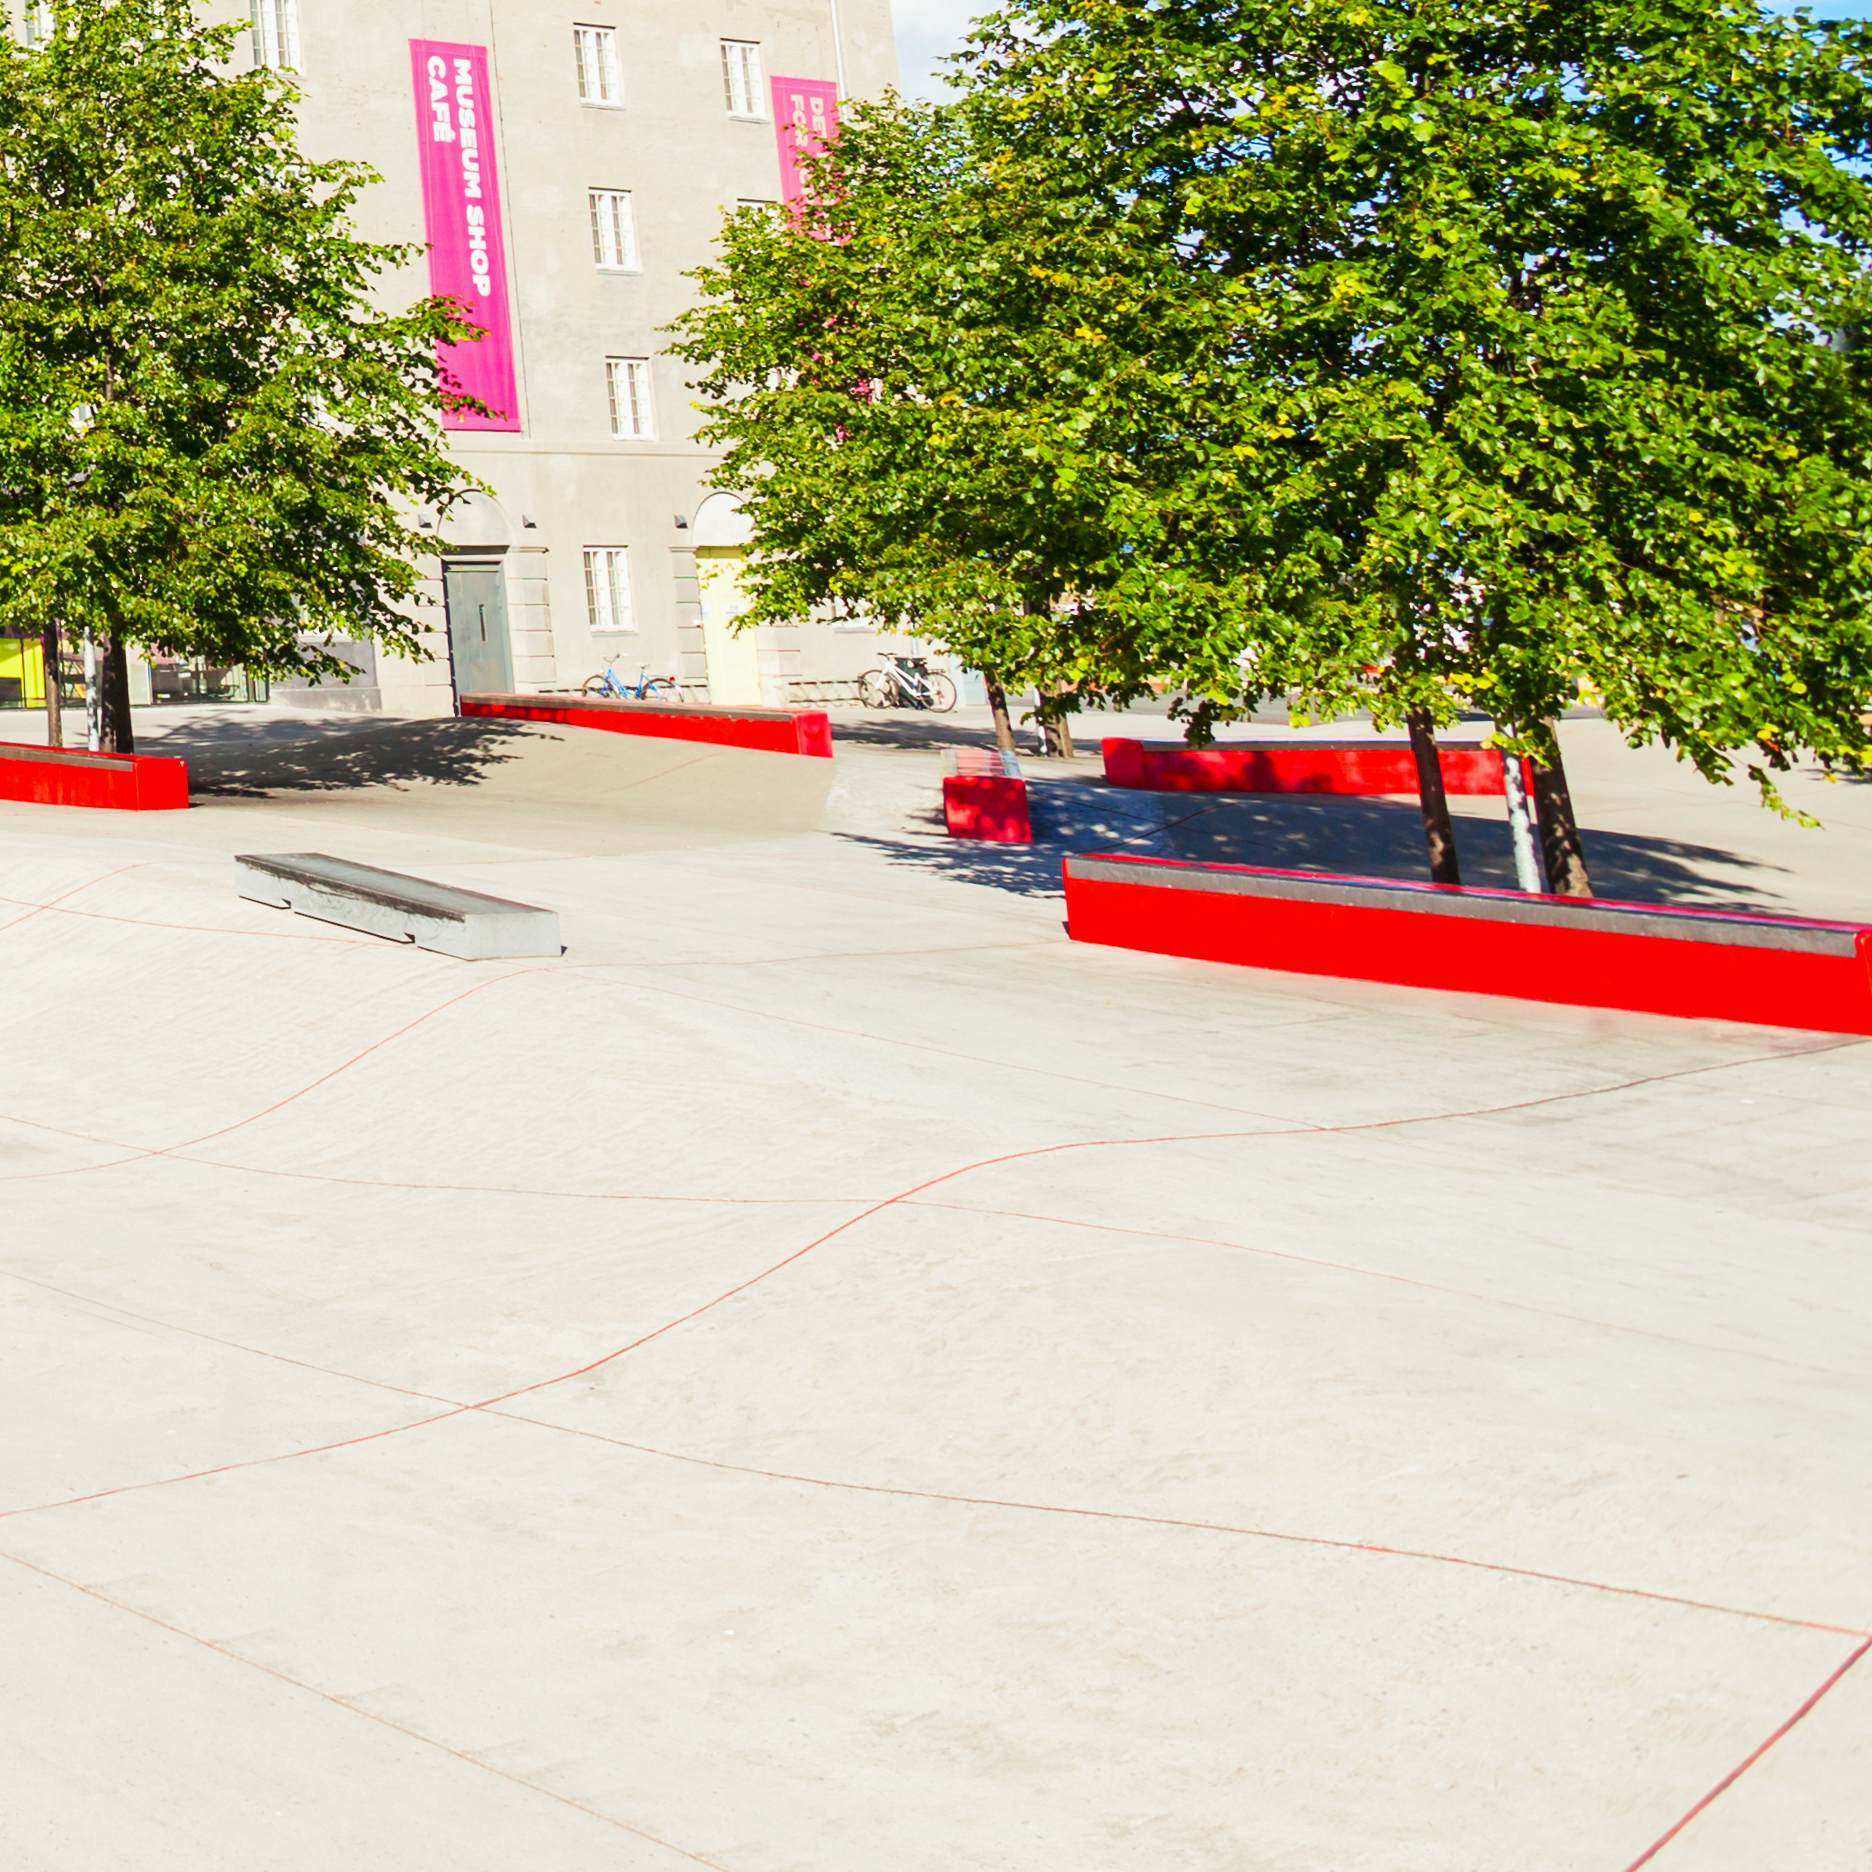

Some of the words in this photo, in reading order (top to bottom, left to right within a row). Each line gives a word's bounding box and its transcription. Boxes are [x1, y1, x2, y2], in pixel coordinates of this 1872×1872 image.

[426, 54, 454, 145] CAFÉ
[453, 58, 483, 200] MUSEUM
[466, 203, 491, 298] SHOP
